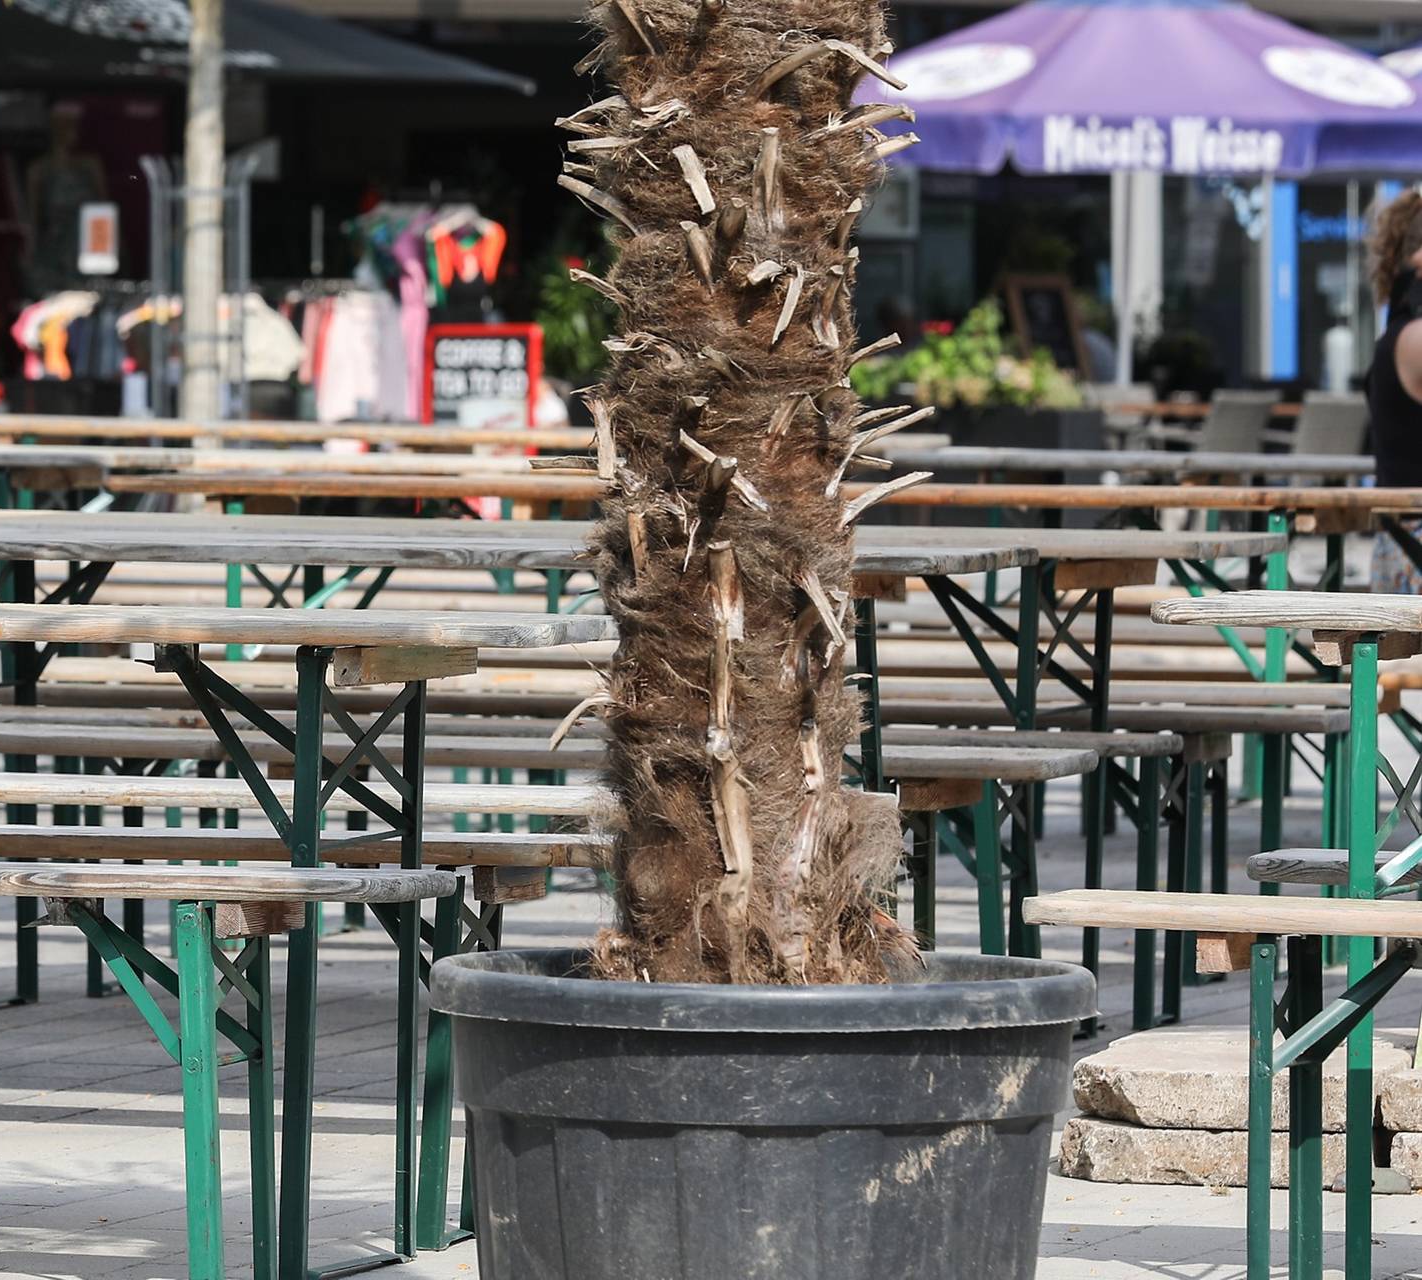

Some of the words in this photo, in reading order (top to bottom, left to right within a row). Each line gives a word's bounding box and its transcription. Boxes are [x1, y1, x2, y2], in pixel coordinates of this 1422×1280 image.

[1171, 116, 1283, 172] Weisse
[435, 338, 503, 369] COFFEE
[433, 369, 468, 398] TEA
[469, 369, 497, 397] TO
[498, 369, 529, 398] GO
